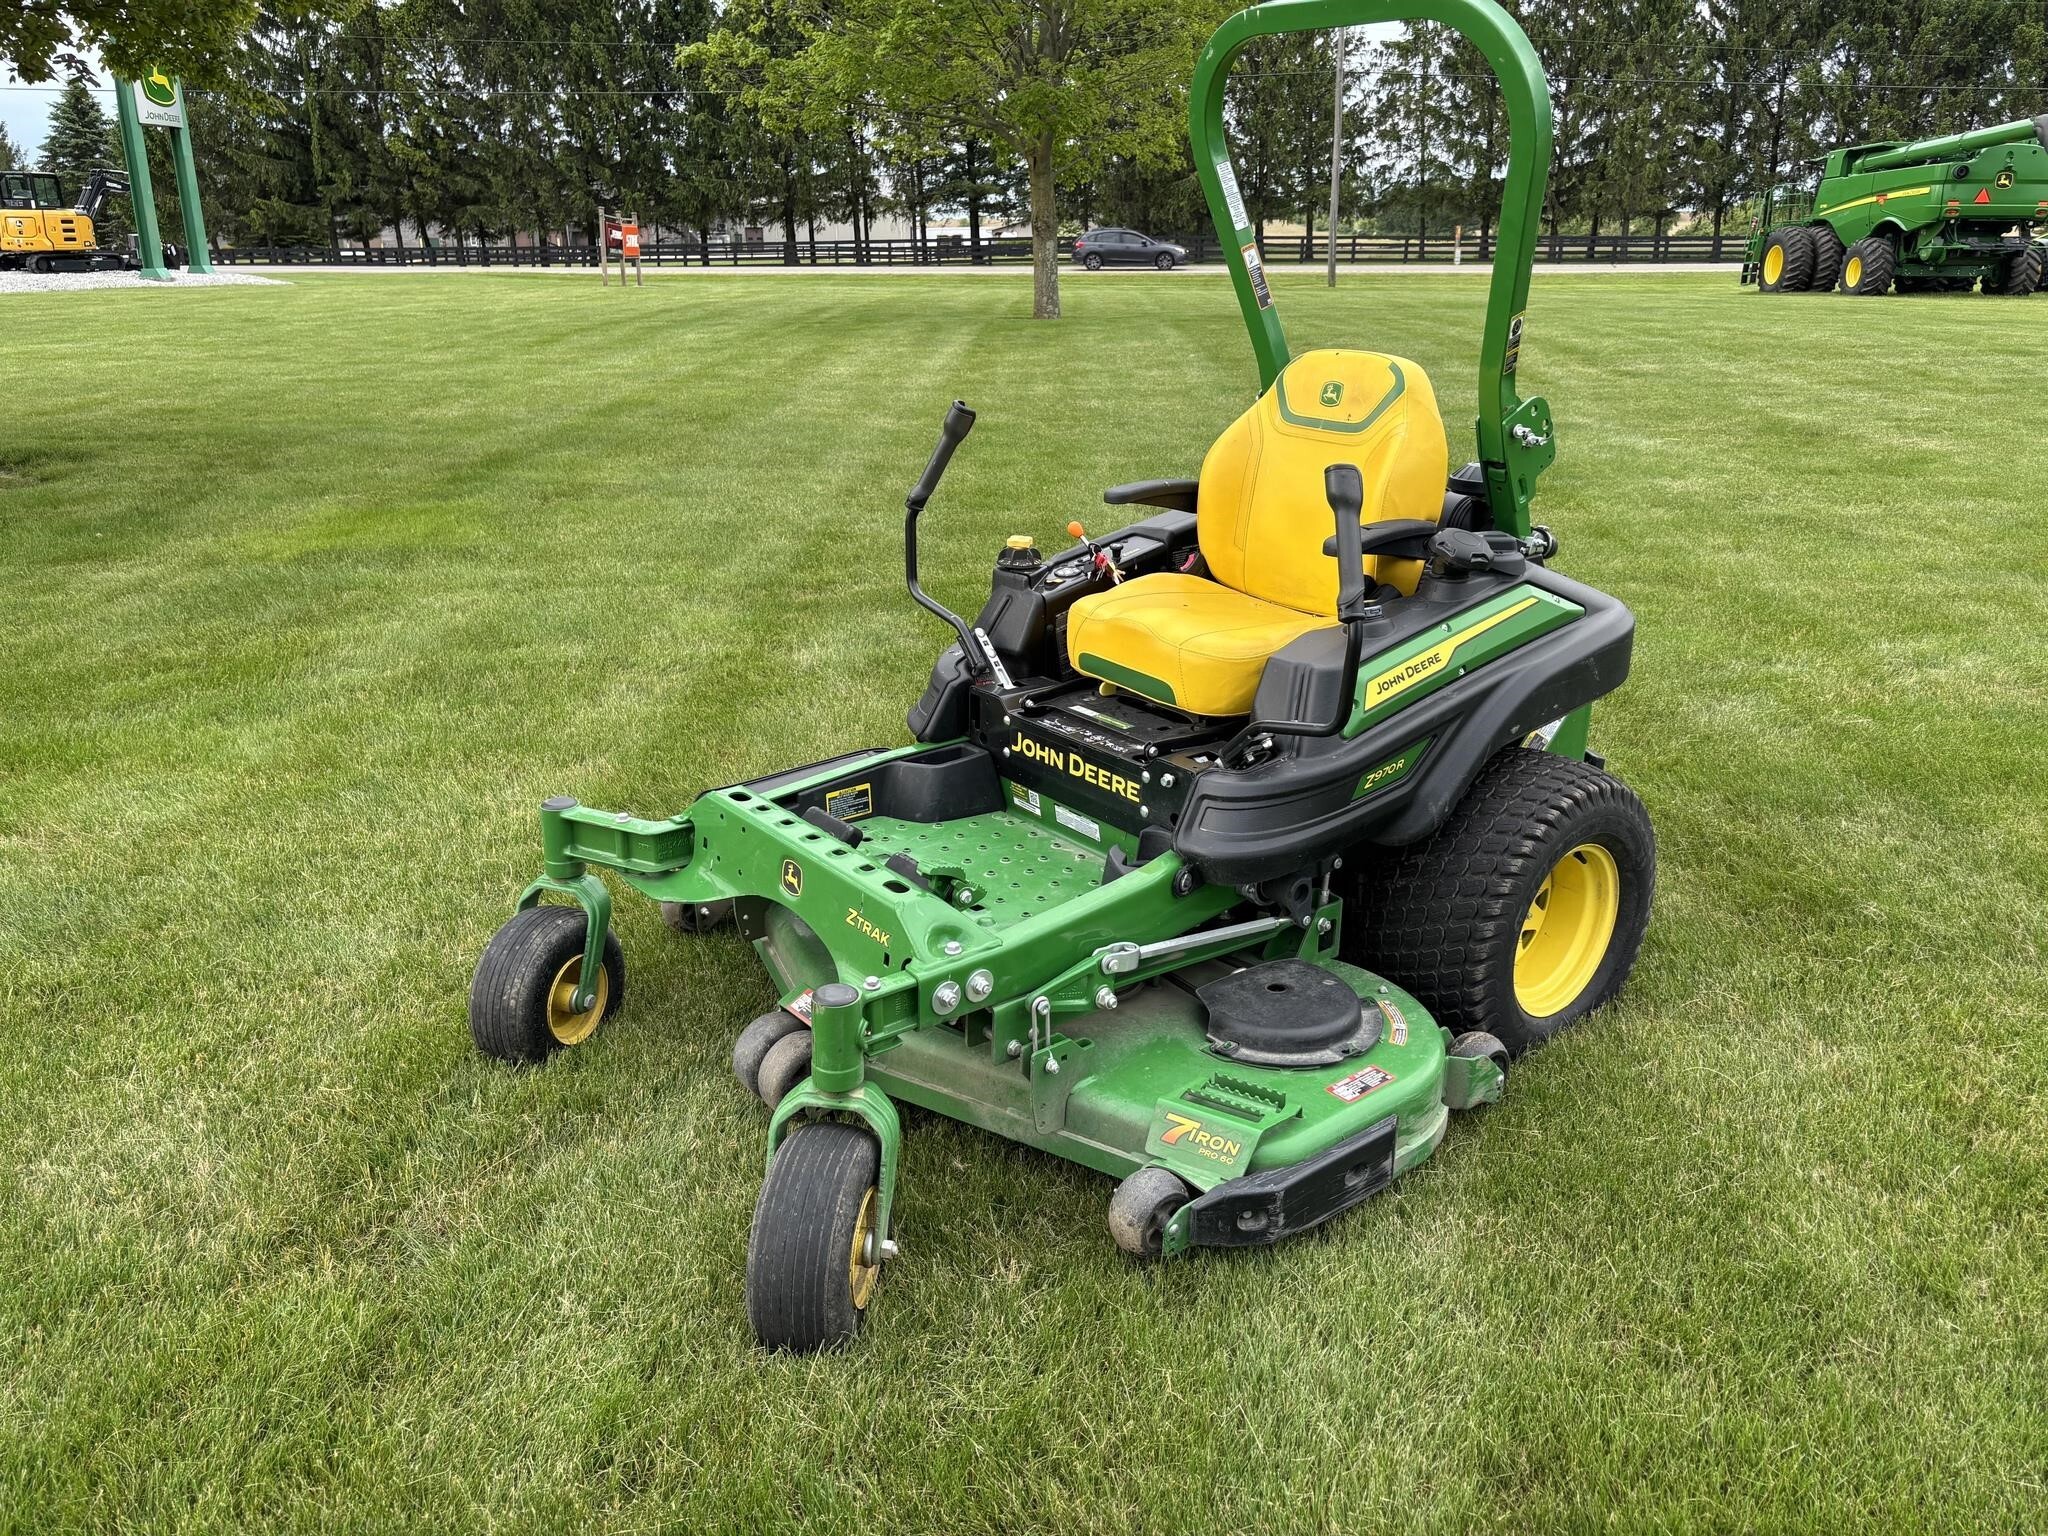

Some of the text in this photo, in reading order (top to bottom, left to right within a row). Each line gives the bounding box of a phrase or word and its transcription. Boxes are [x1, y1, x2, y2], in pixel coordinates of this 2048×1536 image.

[145, 110, 163, 121] JOHN
[1376, 652, 1442, 695] JOHN DEERE
[1011, 732, 1064, 771] JOHN
[1069, 752, 1141, 803] DEERE
[1363, 758, 1405, 790] Z970R
[845, 907, 890, 948] ZTRAK
[1188, 1128, 1241, 1157] IRON
[1198, 1147, 1234, 1166] PRO 60
